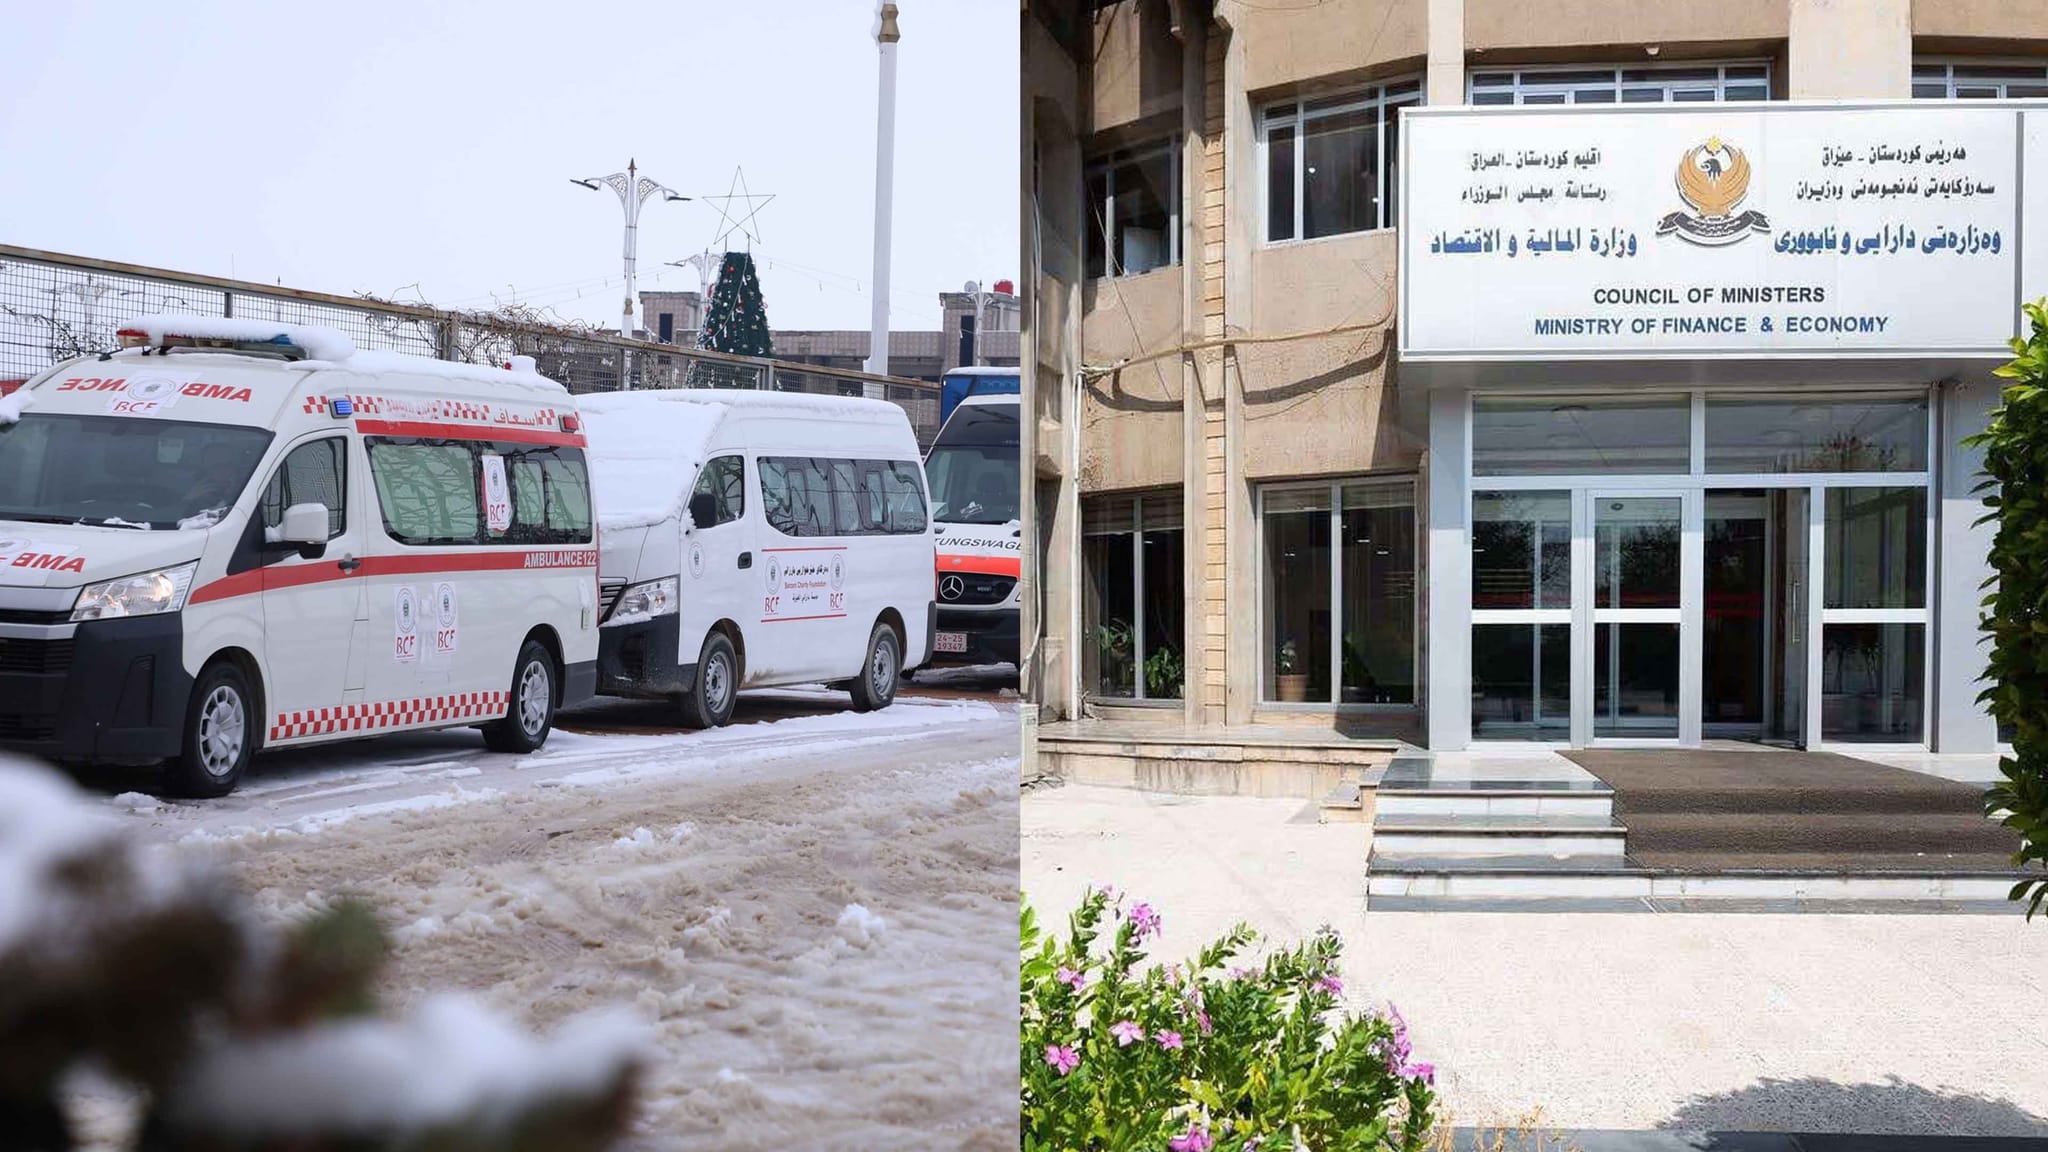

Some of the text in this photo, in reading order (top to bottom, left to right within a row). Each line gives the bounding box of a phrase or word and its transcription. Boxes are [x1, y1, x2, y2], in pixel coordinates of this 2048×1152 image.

[1517, 184, 1553, 203] مجلس
[1431, 227, 1638, 258] وزارة المالية و الاقتصاد
[1593, 287, 1825, 305] COUNCIL OF MINISTERS
[1535, 316, 1889, 335] MINISTRY OF FINANCE & ECONOMY
[113, 401, 158, 413] BCF
[489, 504, 506, 521] BCF
[523, 552, 597, 568] AMBULANCE122
[764, 596, 780, 613] BCF
[830, 593, 844, 609] BCF
[396, 635, 415, 654] BCF
[437, 629, 455, 648] BCF
